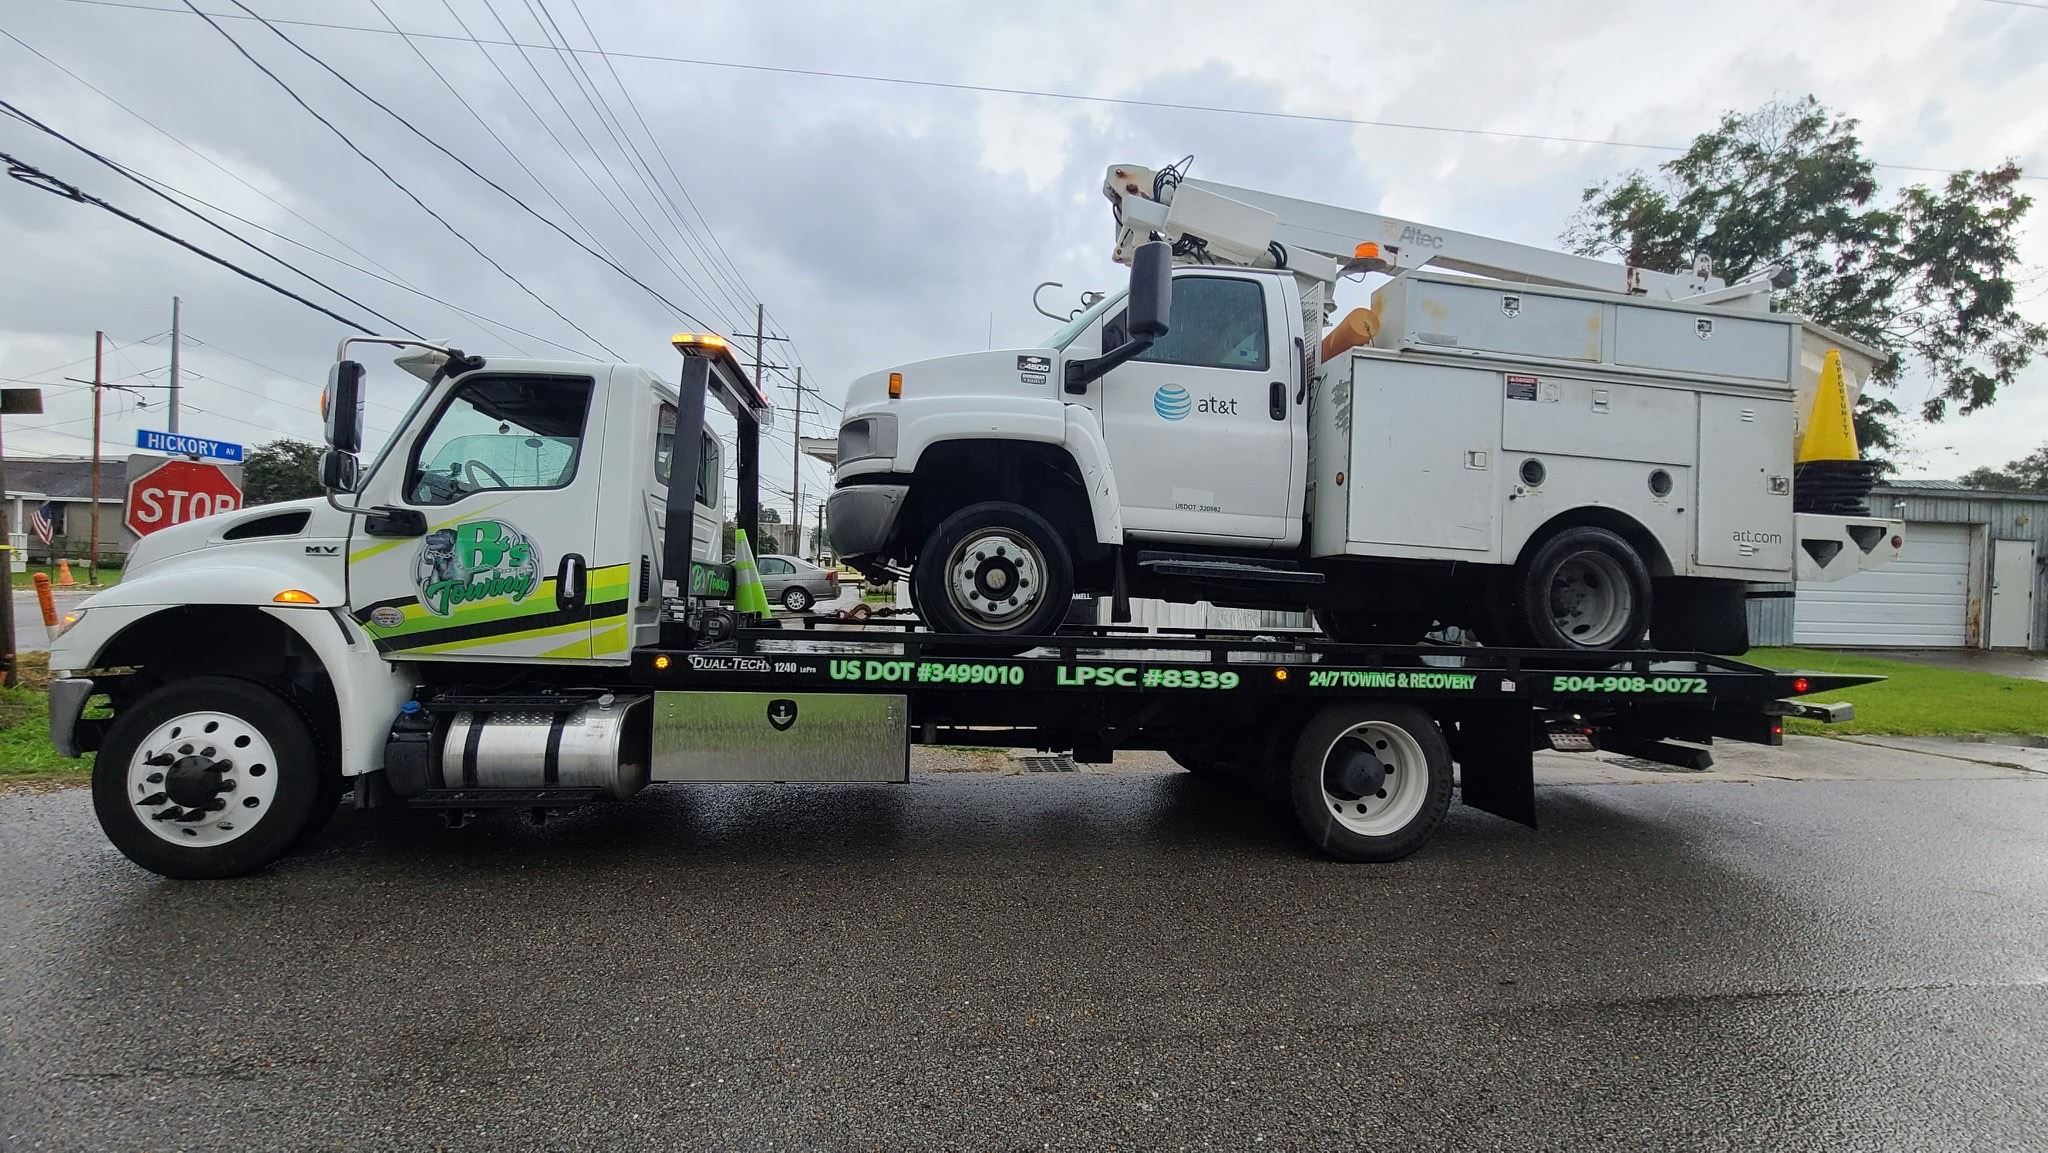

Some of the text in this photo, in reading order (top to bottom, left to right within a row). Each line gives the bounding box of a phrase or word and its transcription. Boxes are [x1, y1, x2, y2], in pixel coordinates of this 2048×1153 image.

[1399, 226, 1443, 249] Altec
[1019, 363, 1050, 372] C4500
[1197, 396, 1238, 415] at&t
[147, 433, 235, 456] HICKORY AV
[137, 487, 235, 523] STOP
[1175, 503, 1196, 511] USDOT
[1733, 530, 1782, 544] att.com
[305, 546, 338, 554] MV
[425, 571, 534, 616] Towing
[692, 657, 767, 670] DUAL-TECH
[774, 662, 797, 673] 1240
[829, 660, 1025, 685] US DOT #3499010
[1057, 665, 1240, 690] LPSC #8339
[1309, 670, 1477, 690] 24/7 TOWING & RECOVERY
[1552, 676, 1708, 694] 504-908-0072
